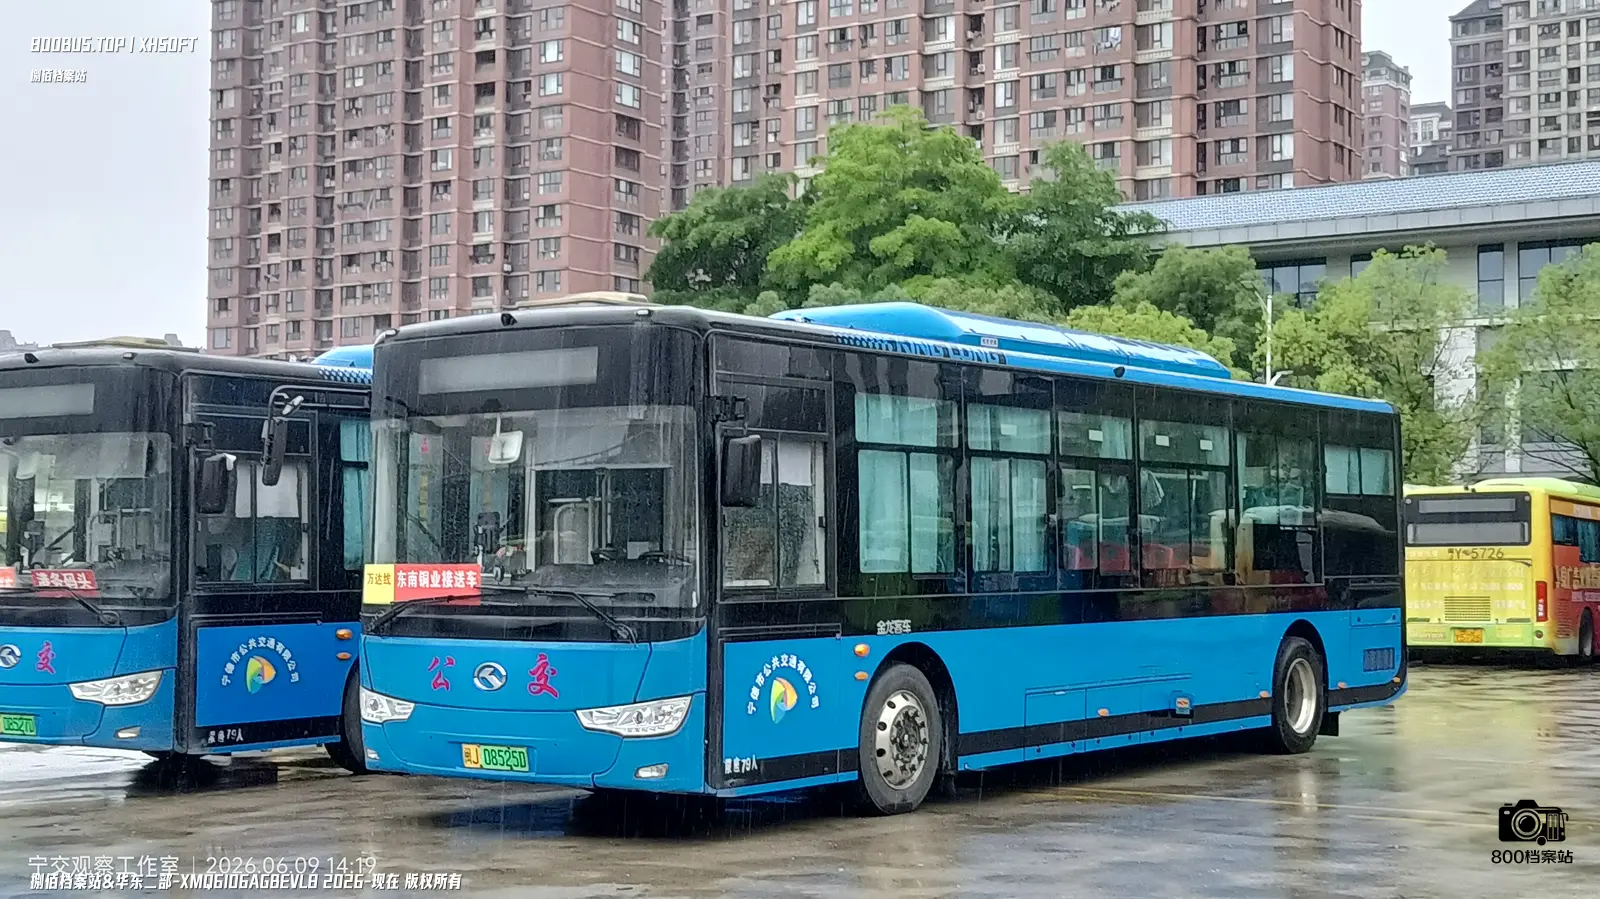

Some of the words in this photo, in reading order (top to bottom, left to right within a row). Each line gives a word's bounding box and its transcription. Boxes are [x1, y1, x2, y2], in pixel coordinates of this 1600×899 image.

[366, 572, 392, 586] 万达线
[396, 569, 477, 589] 东南铜业接送车
[876, 619, 912, 636] 金龙客车
[36, 640, 56, 675] 交
[428, 656, 456, 692] 公
[527, 653, 559, 699] 交
